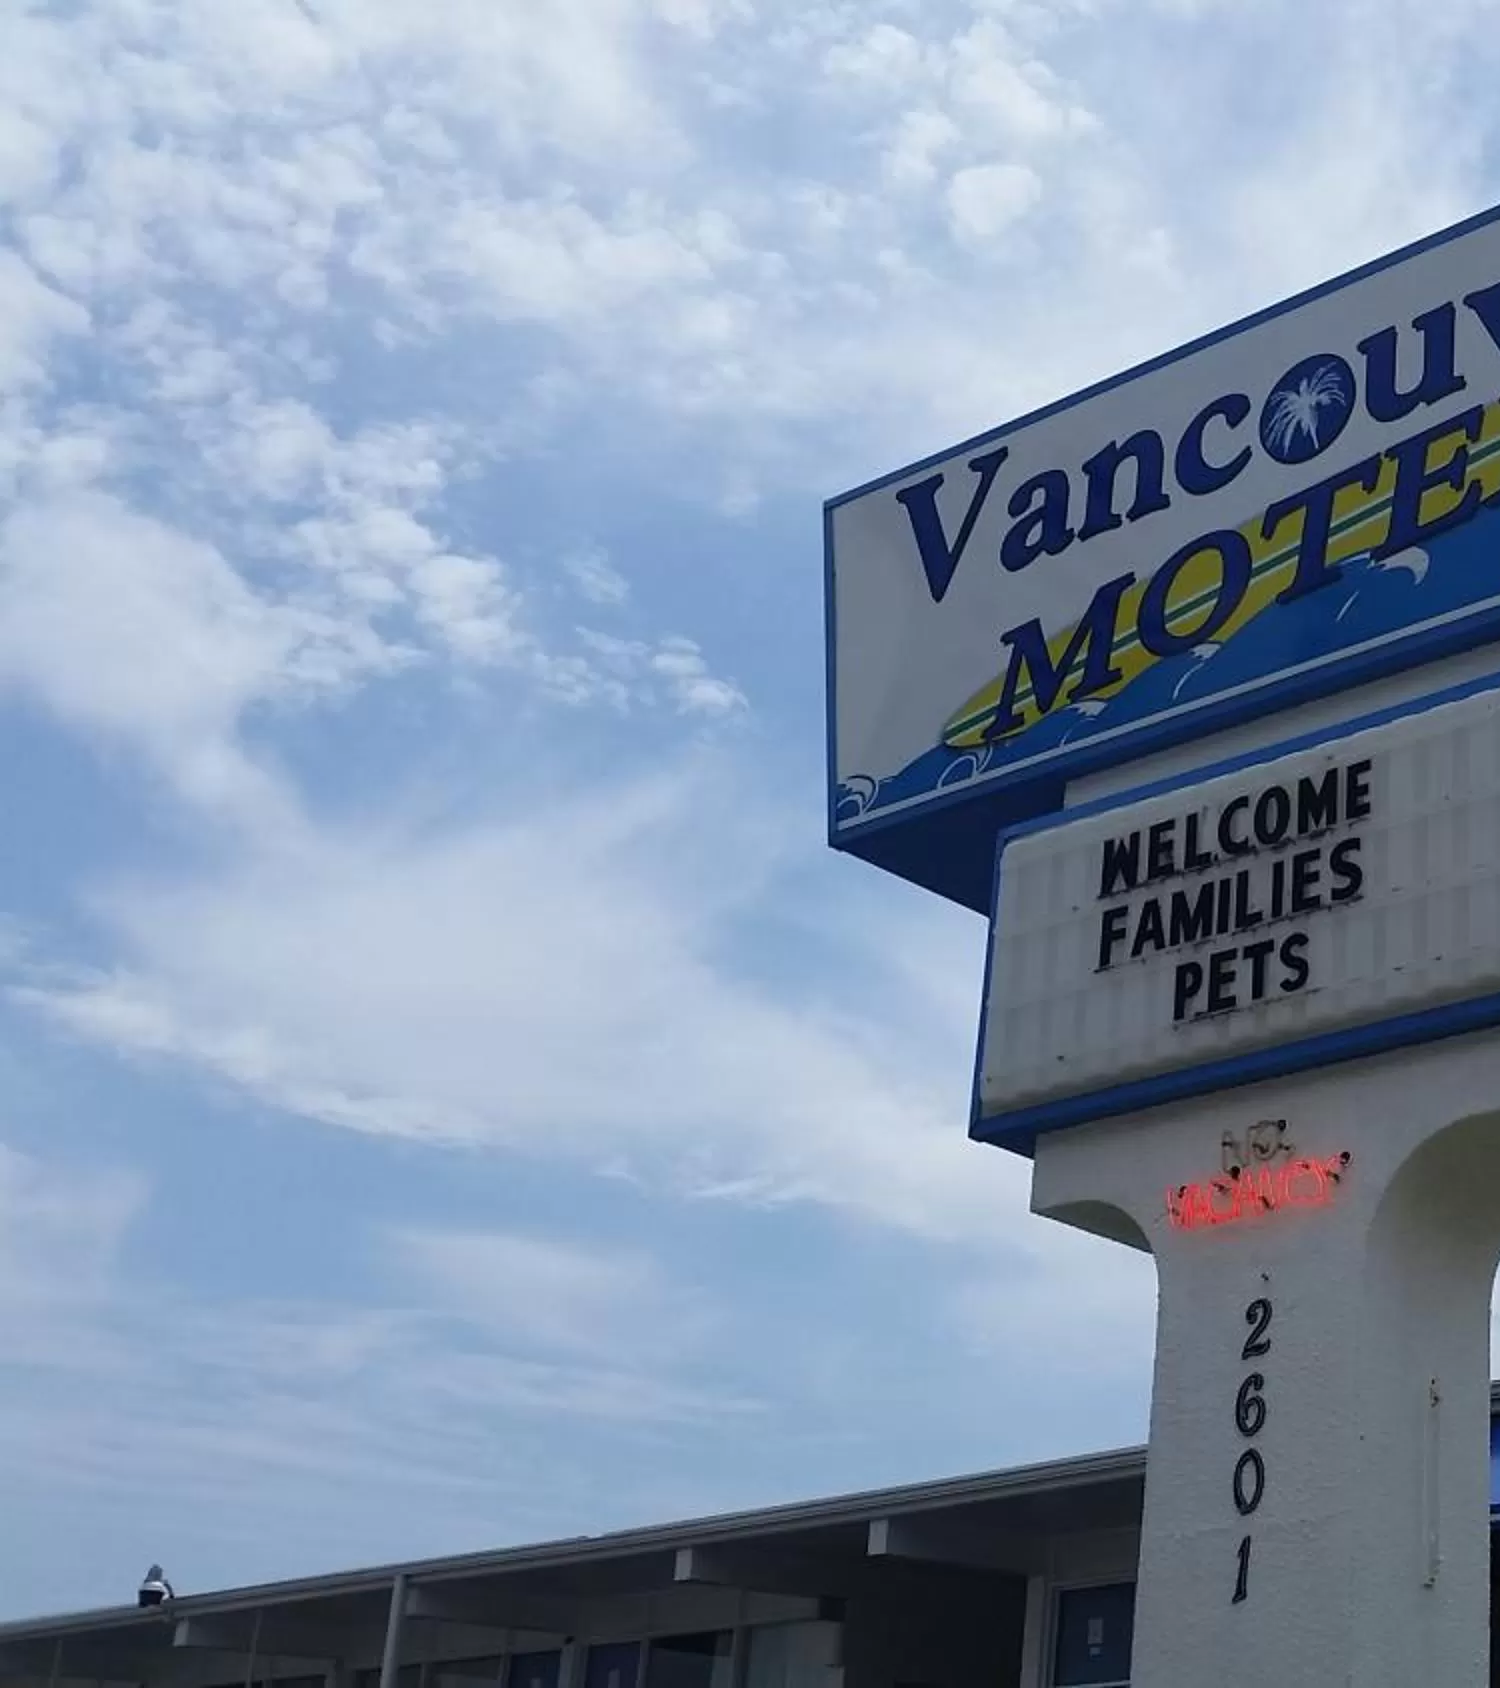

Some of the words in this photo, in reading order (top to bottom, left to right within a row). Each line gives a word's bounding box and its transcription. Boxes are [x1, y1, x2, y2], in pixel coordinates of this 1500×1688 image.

[1100, 760, 1373, 895] WELCOME
[1099, 838, 1364, 969] FAMILIES
[1173, 934, 1310, 1020] PETS
[1231, 1298, 1273, 1604] 2601
